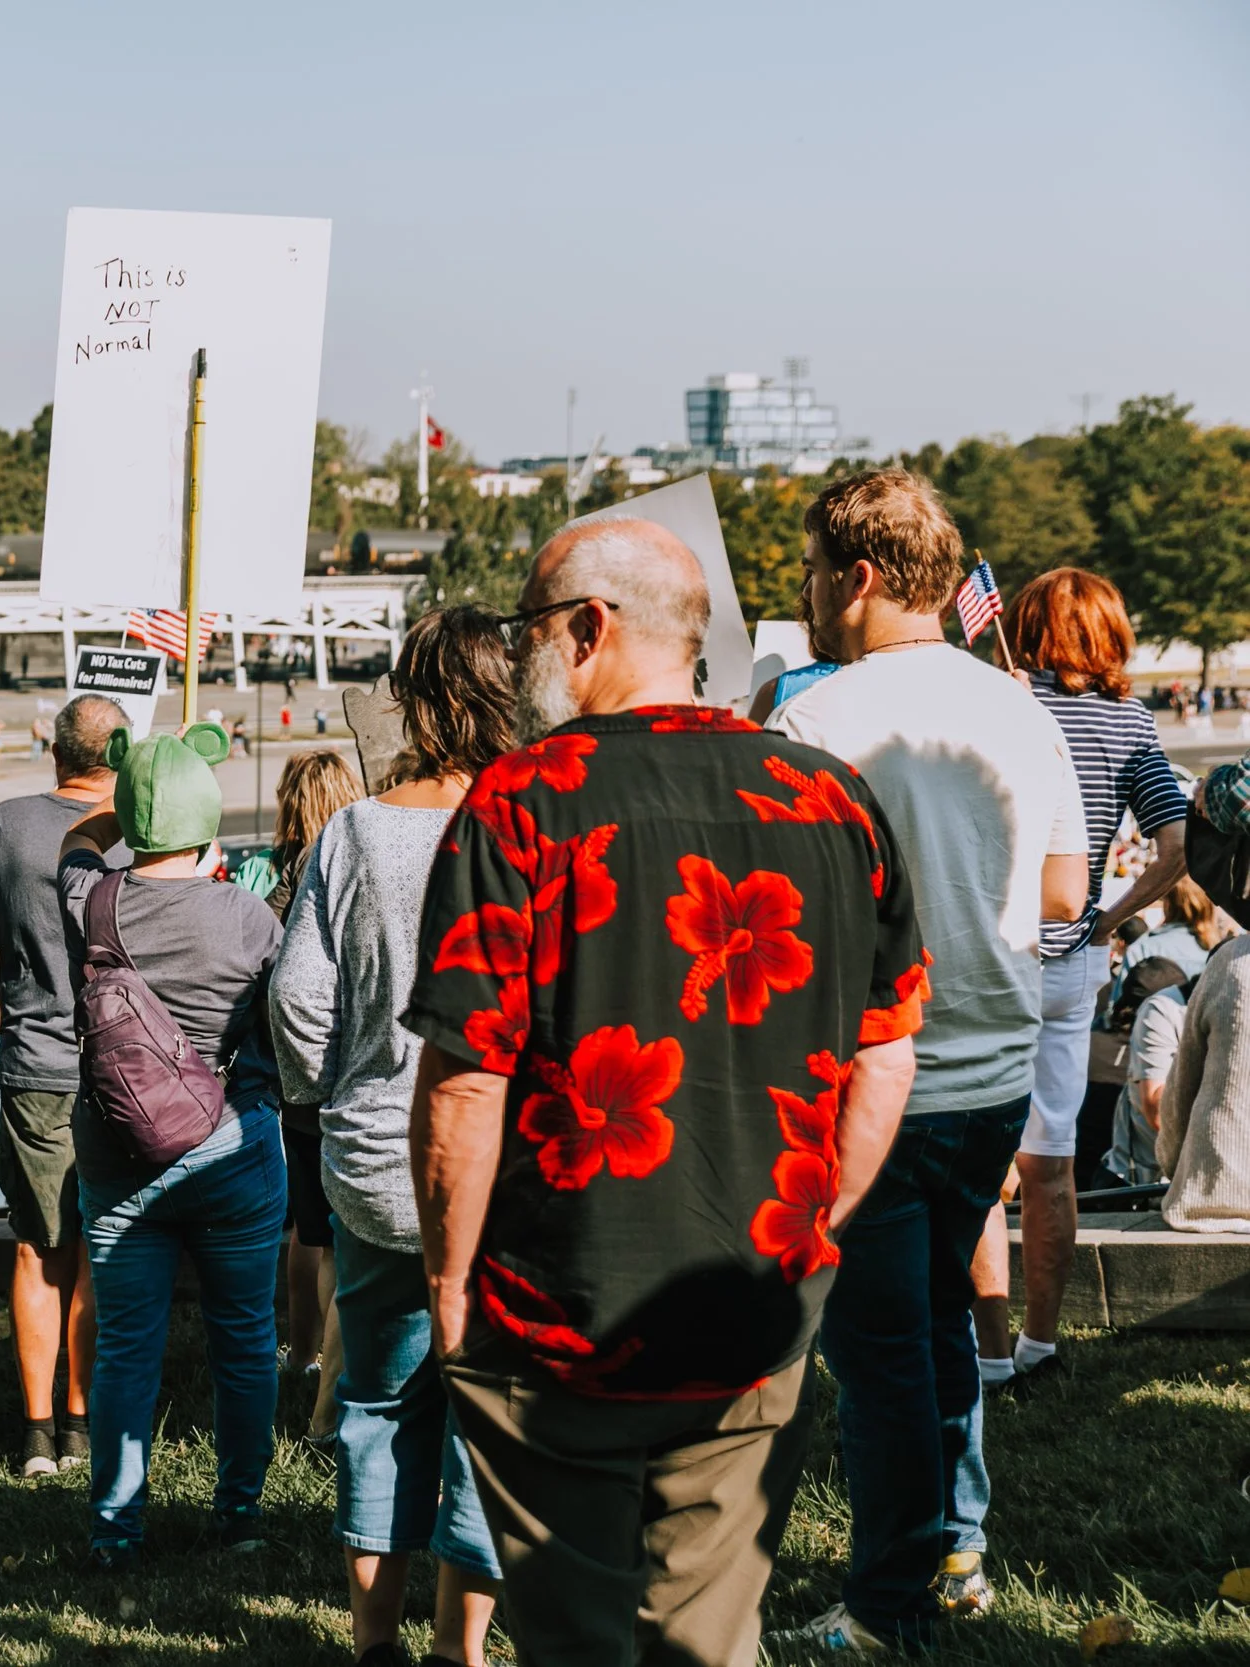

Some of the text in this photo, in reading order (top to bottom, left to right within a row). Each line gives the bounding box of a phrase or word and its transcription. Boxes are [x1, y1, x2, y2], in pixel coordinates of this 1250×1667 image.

[94, 257, 187, 289] This is
[104, 299, 161, 321] NOT
[75, 328, 151, 364] Normal
[91, 654, 147, 671] NO Tax Cuts
[78, 672, 152, 690] for Billionaires!
